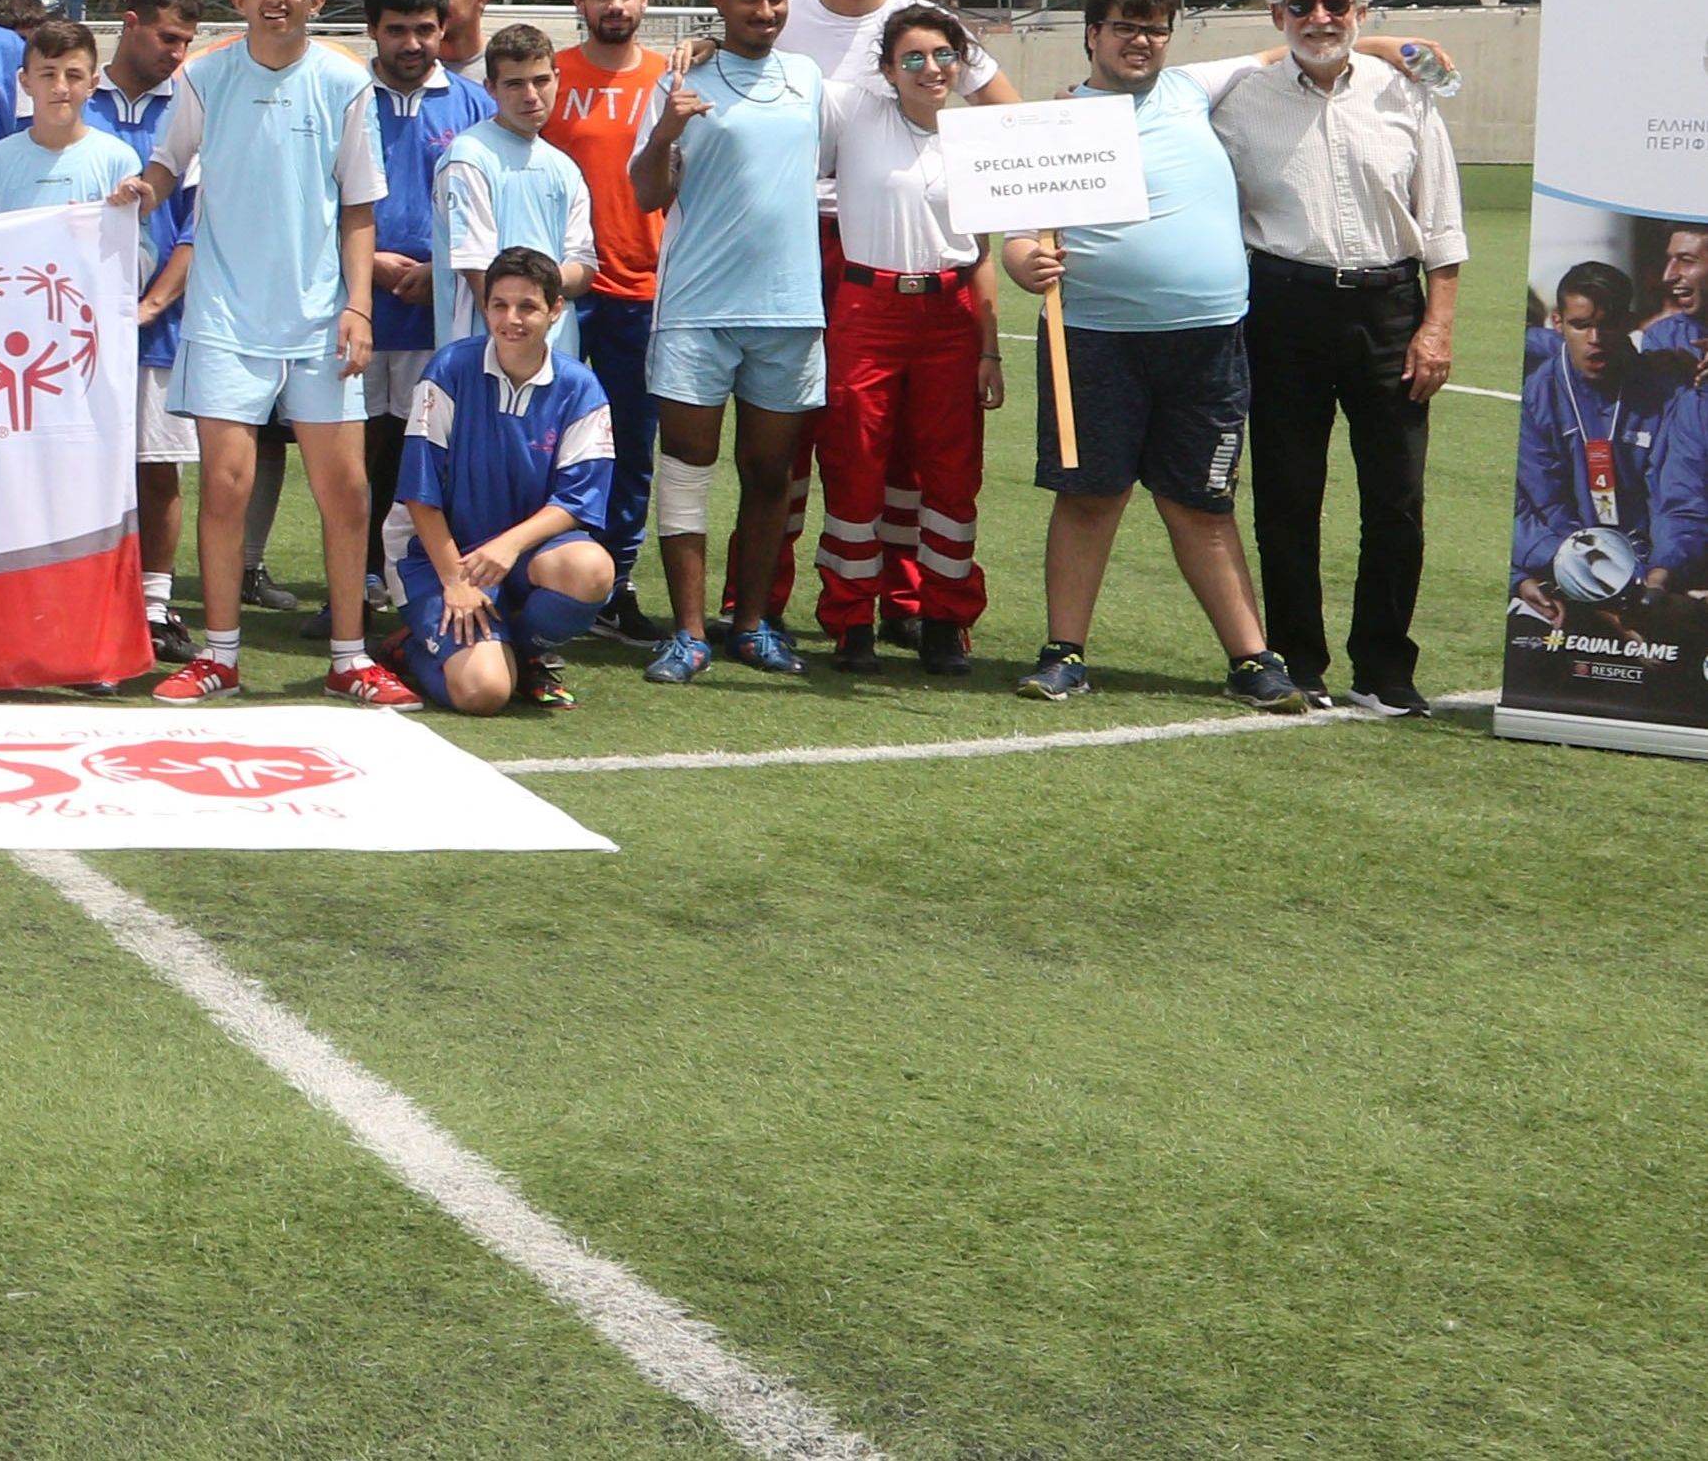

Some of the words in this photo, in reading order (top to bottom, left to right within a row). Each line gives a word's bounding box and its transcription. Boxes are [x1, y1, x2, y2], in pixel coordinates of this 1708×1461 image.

[1647, 136, 1708, 150] ΠΕΡΙΦ
[974, 157, 1034, 173] SPECIAL
[1037, 150, 1116, 168] OLYMPICS
[991, 183, 1023, 197] ΝΕΟ
[1027, 177, 1107, 195] ΗΡΑΚΛΕΙΟ
[1591, 665, 1644, 680] RESPECT
